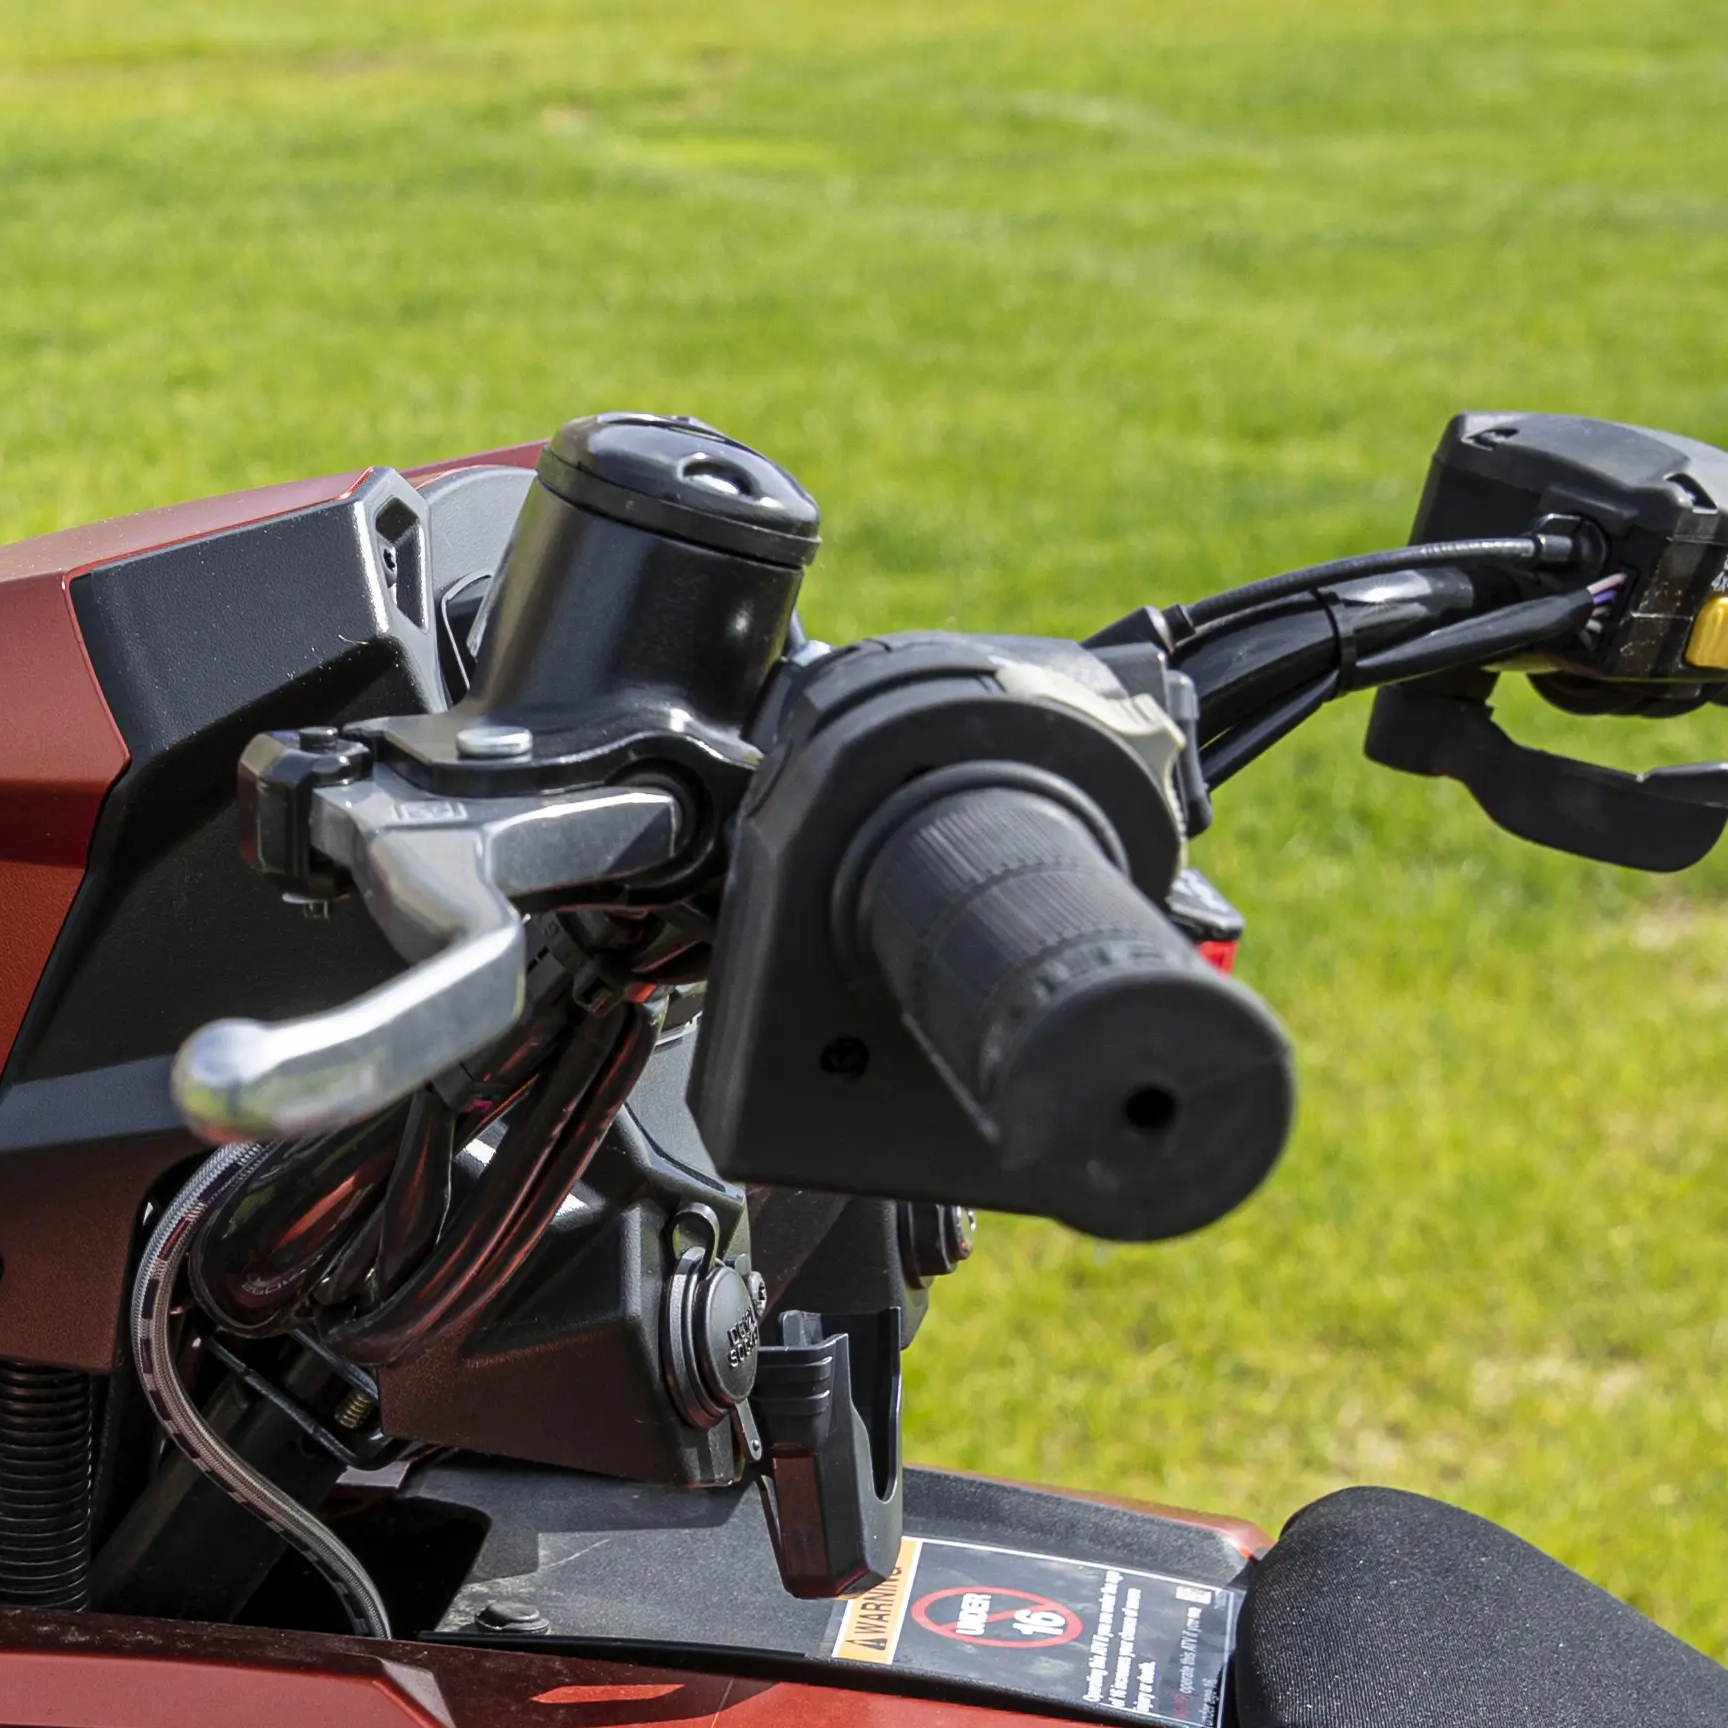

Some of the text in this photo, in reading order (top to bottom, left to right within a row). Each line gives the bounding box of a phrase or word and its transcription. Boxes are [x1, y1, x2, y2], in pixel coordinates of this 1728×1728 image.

[956, 1592, 992, 1636] UNDER
[1013, 1608, 1067, 1637] 16
[1180, 1636, 1198, 1653] ATV
